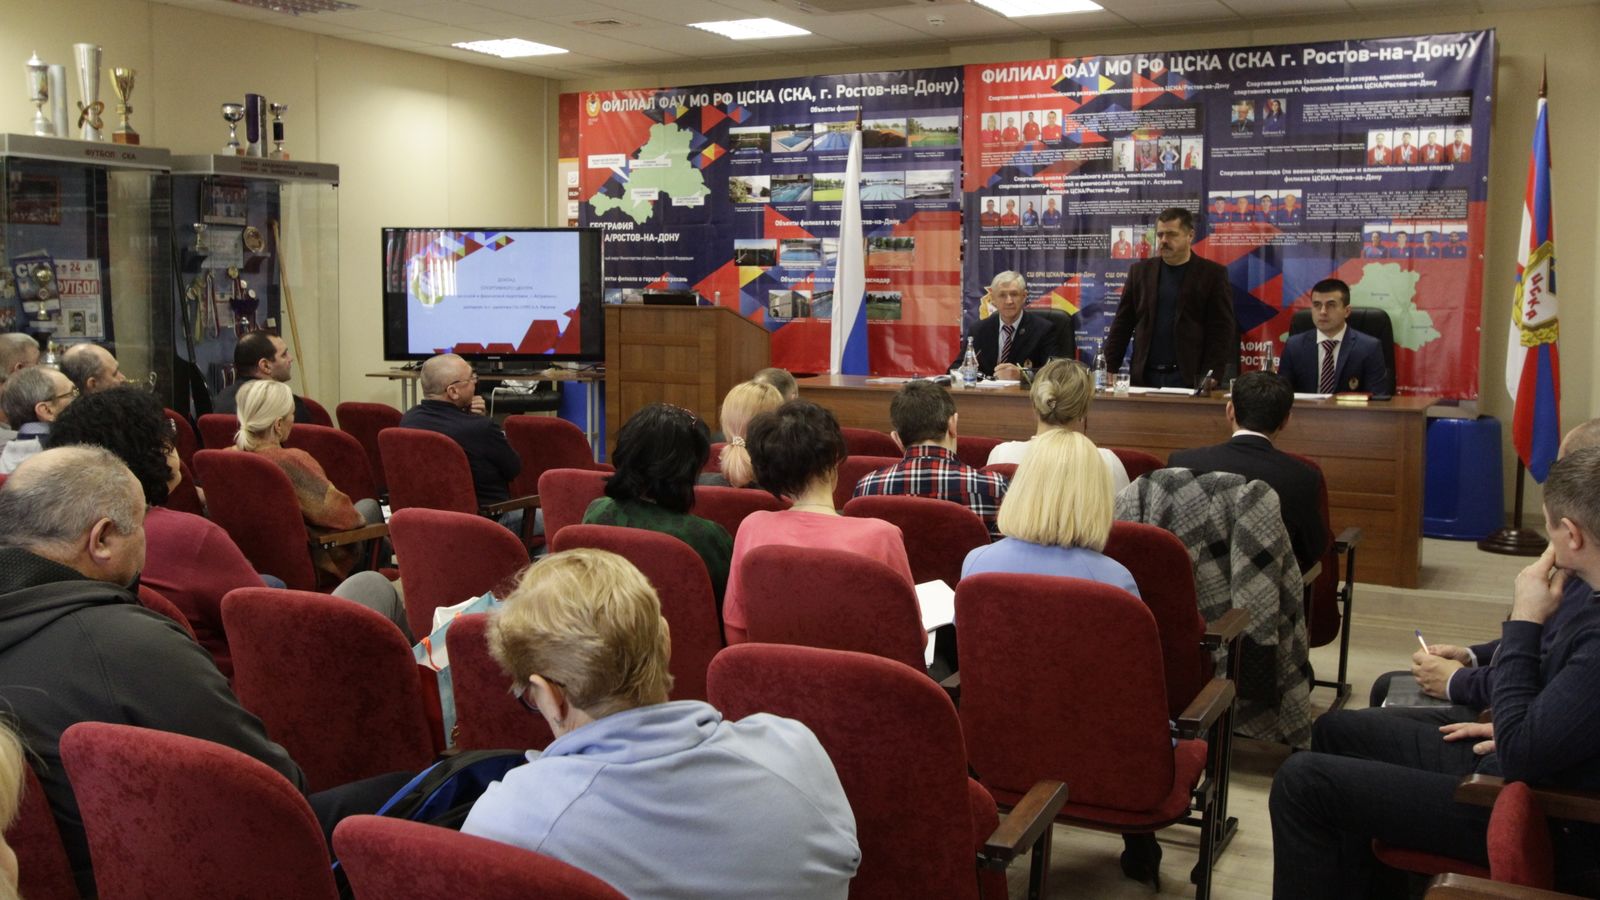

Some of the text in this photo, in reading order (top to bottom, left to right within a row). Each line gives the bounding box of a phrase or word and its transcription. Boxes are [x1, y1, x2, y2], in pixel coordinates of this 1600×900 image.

[981, 37, 1477, 84] ФИЛИАЛ ФАУ МО РФ ЦСКА (СКА г. Ростов-на-Дону)
[1301, 85, 1334, 93] Краснодар
[1364, 80, 1437, 89] ЦСКА/Ростов-на-Дону
[602, 77, 959, 112] ФИЛИАЛ ФАУ МО РФ ЦСКА (СКА, г. Ростов-на-Дону)
[85, 149, 136, 160] ФУТБОЛ СКА
[1311, 173, 1382, 182] ЦСКА/Ростов-на-Дону
[589, 222, 634, 230] ГЕОГРАФИЯ
[800, 219, 824, 227] филиала
[861, 218, 900, 226] стов-на-Дону
[604, 233, 680, 243] А/РОСТОВ-НА-ДОНУ
[618, 275, 638, 283] филиала
[661, 276, 688, 284] Астрахань
[806, 276, 831, 284] филиала
[865, 277, 890, 285] аснодар
[1526, 273, 1544, 320] ЦСКА
[1240, 341, 1268, 352] АФИЯ
[1240, 356, 1280, 367] РОСТВ
